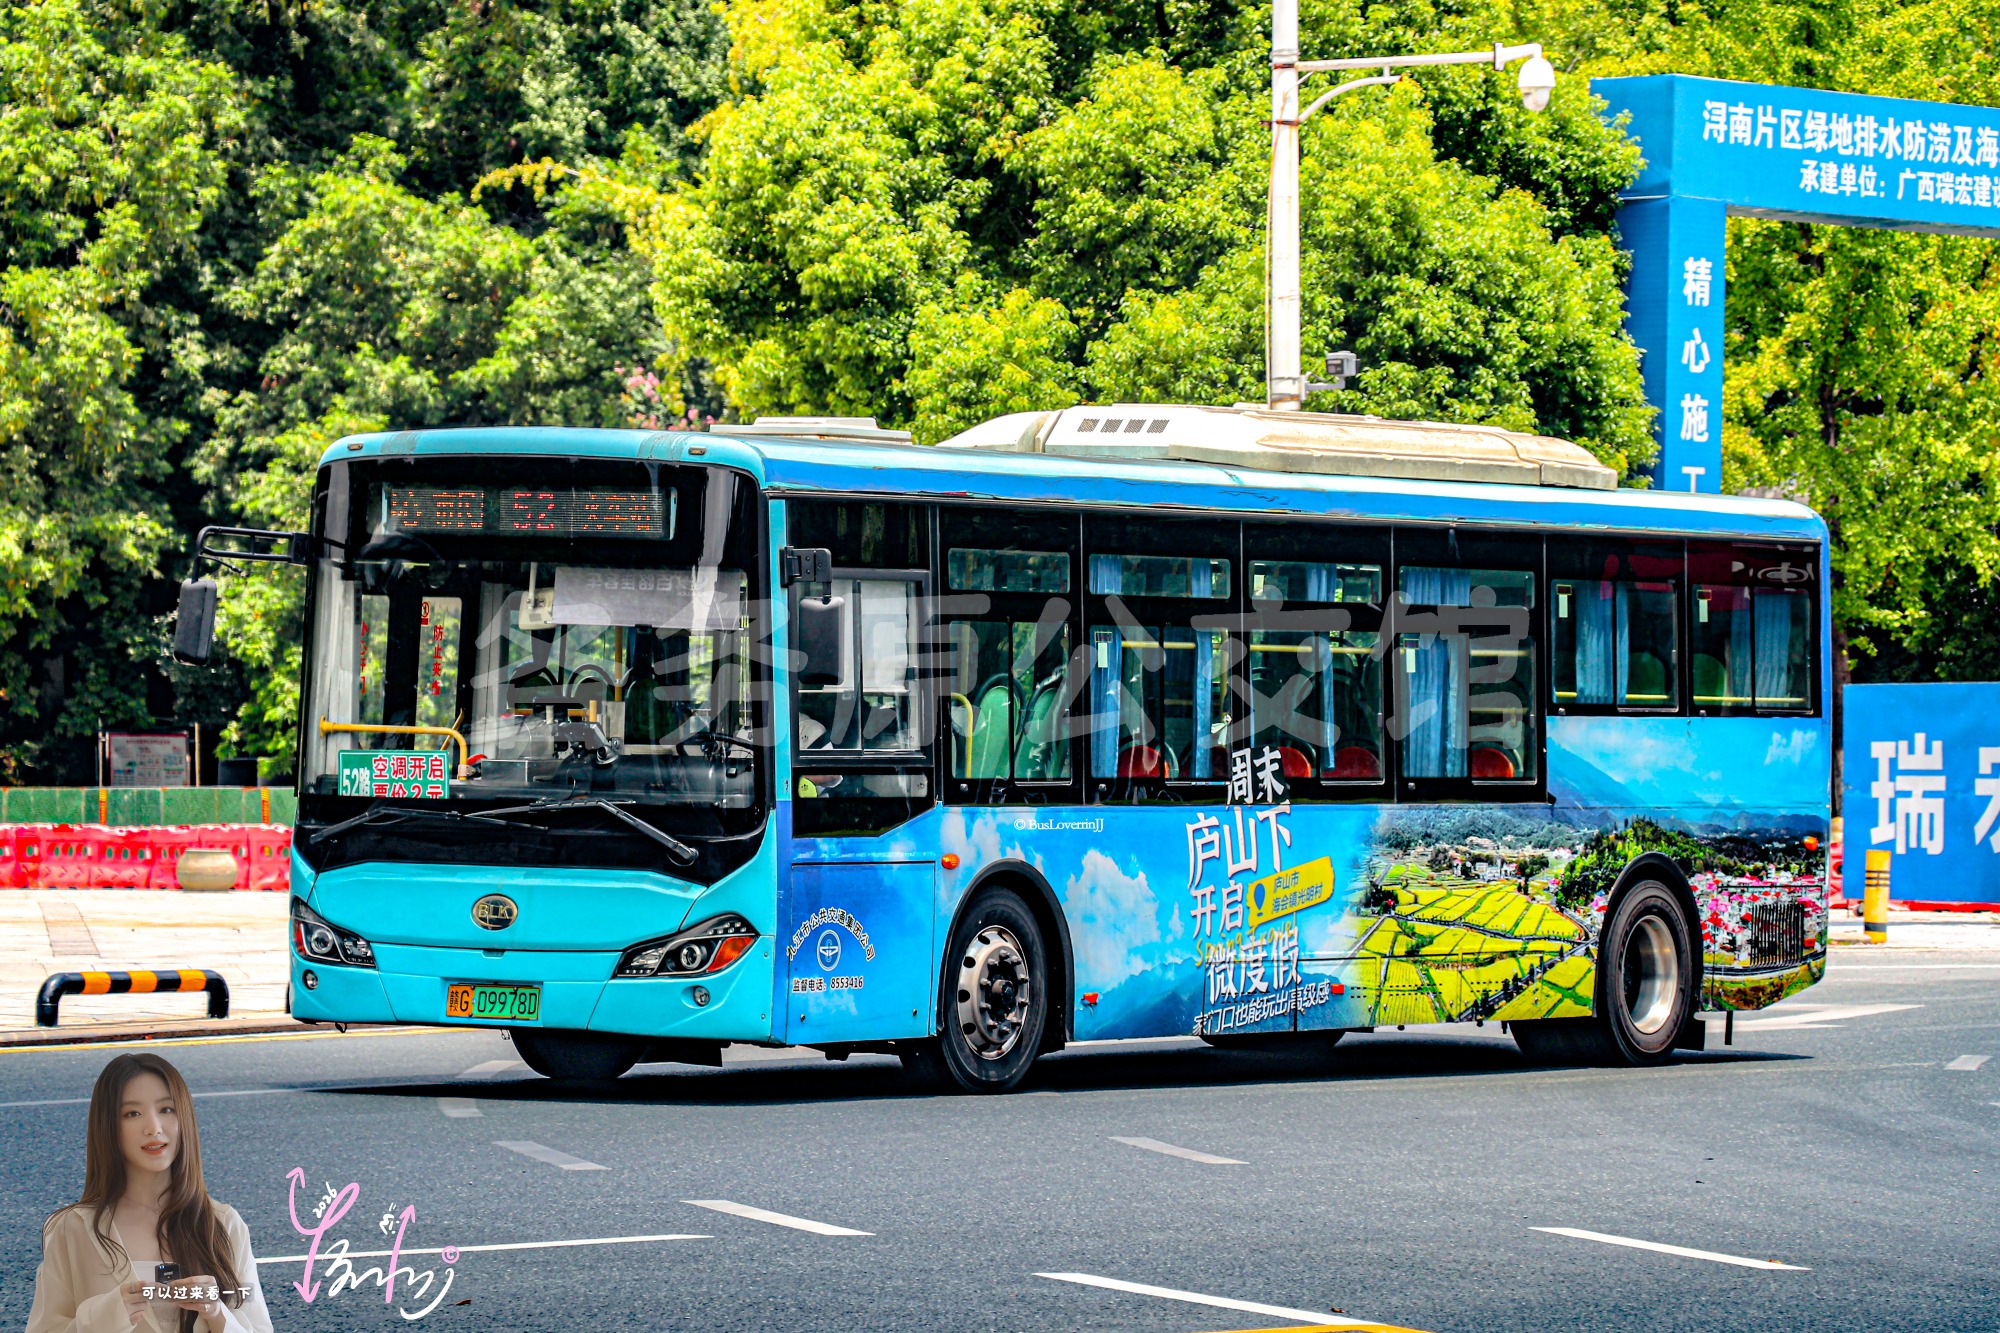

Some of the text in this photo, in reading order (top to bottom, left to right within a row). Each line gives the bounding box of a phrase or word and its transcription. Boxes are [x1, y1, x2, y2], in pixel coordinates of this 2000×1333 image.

[1703, 99, 1999, 168] 浔南片区绿地排水防涝及海
[513, 492, 555, 530] 52
[342, 766, 371, 797] 52路
[372, 754, 445, 780] 空调开启
[1226, 745, 1285, 810] 周末
[1186, 800, 1292, 890] 庐山下
[1190, 880, 1244, 939] 开启
[1273, 870, 1300, 894] 庐山市
[1207, 926, 1302, 1005] 微度假
[1193, 978, 1331, 1036] 家门口也能玩出高级感
